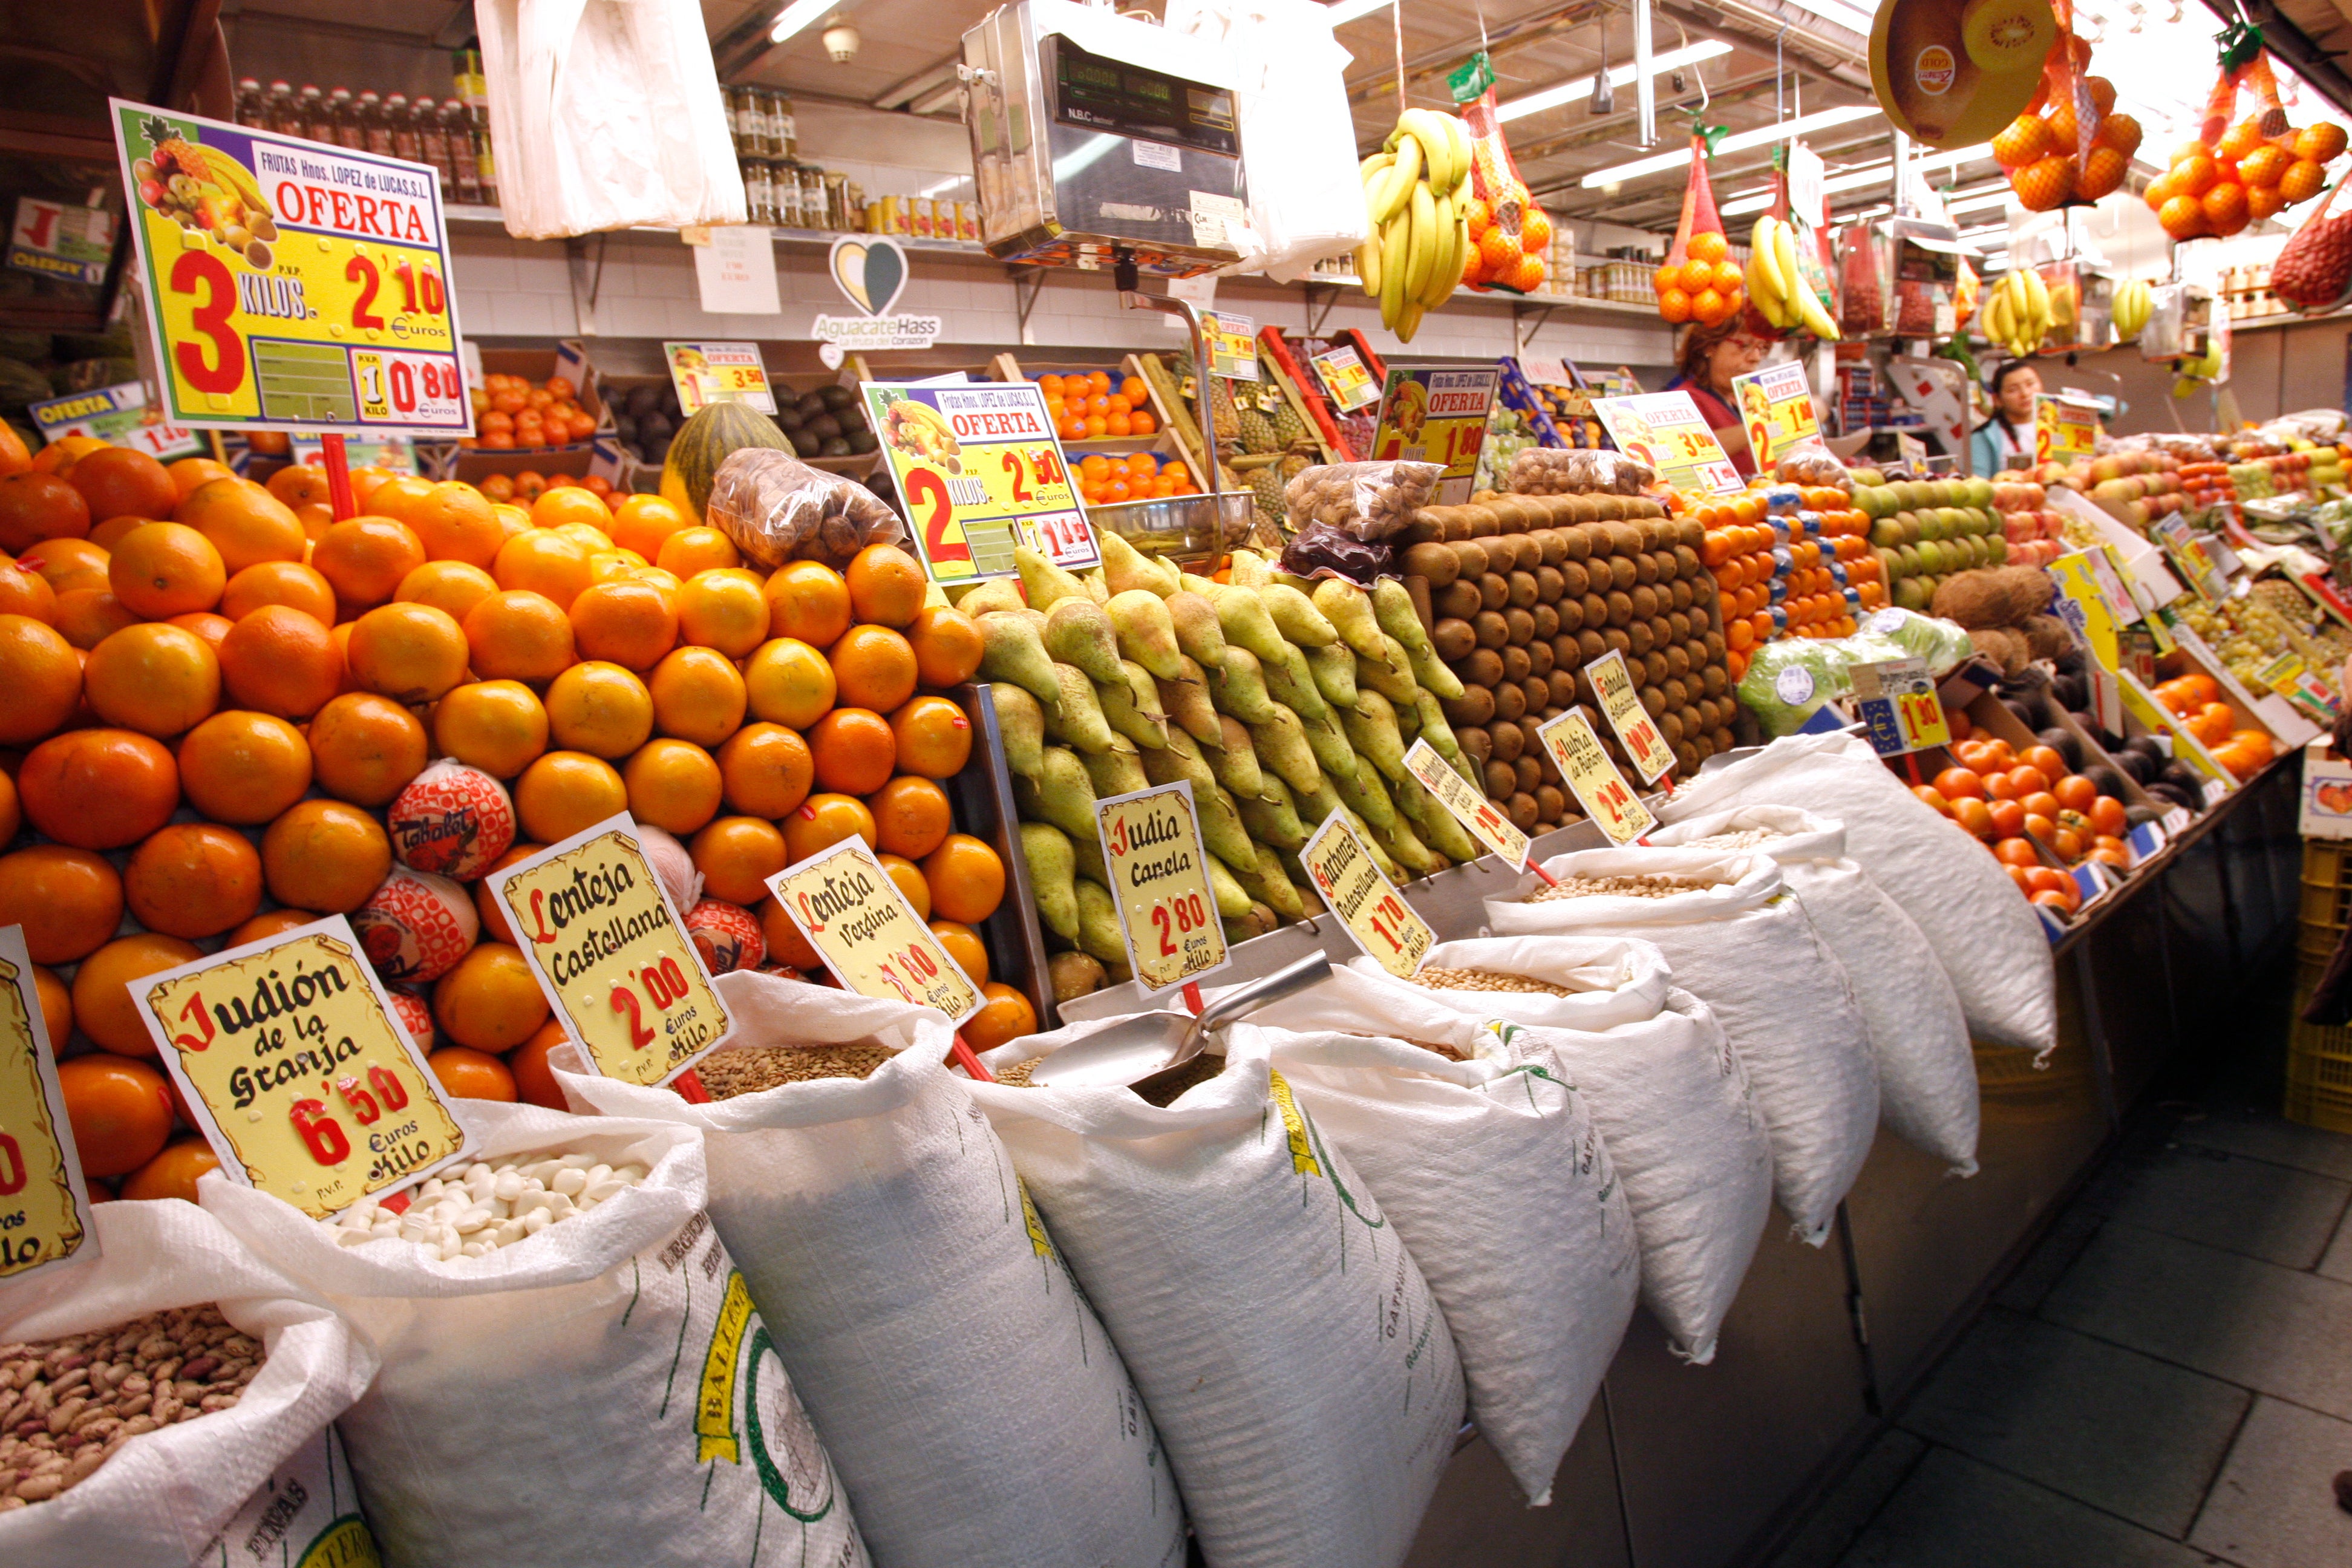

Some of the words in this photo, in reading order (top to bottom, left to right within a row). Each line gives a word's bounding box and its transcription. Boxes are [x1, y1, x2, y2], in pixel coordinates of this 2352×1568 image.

[1922, 57, 1950, 67] GOLD
[261, 151, 297, 176] FRUTAS
[301, 160, 330, 182] Hnos.
[332, 166, 362, 187] LOPEZ
[364, 172, 377, 190] de
[276, 181, 429, 243] OFERTA
[278, 265, 302, 276] P.V.P.
[345, 255, 444, 331] 2'10
[171, 250, 245, 394] 3
[817, 318, 936, 338] AguacateHass
[707, 354, 754, 363] OFERTA
[362, 365, 383, 404] 1
[679, 374, 705, 407] 1
[943, 394, 961, 410] Frutas
[962, 393, 979, 408] Hnos.
[979, 393, 997, 408] LOPEZ
[998, 393, 1005, 407] de
[1429, 392, 1484, 413] OFERTA
[1767, 380, 1804, 399] OFERTA
[36, 393, 116, 424] OFERTA
[365, 407, 387, 416] KILO
[952, 412, 1041, 437] OFERTA
[1646, 407, 1694, 423] OFERTA
[1753, 422, 1777, 472] 2
[2037, 428, 2051, 464] 2
[905, 468, 971, 562] 2
[1026, 528, 1042, 554] 1
[1556, 731, 1592, 765] Alubia
[1314, 834, 1359, 899] Garbanzo
[529, 862, 635, 944] Lenteja
[797, 870, 875, 933] Lenteja
[1152, 893, 1206, 957] 2'80
[174, 960, 350, 1052] Judión
[610, 956, 689, 1051] 2'00
[254, 1027, 286, 1057] de
[293, 1013, 328, 1041] la
[671, 1023, 708, 1058] Kilo
[229, 1034, 364, 1110] Granja
[289, 1067, 410, 1166] 6'50
[374, 1140, 431, 1181] Kilo
[316, 1181, 344, 1201] P.V.P.
